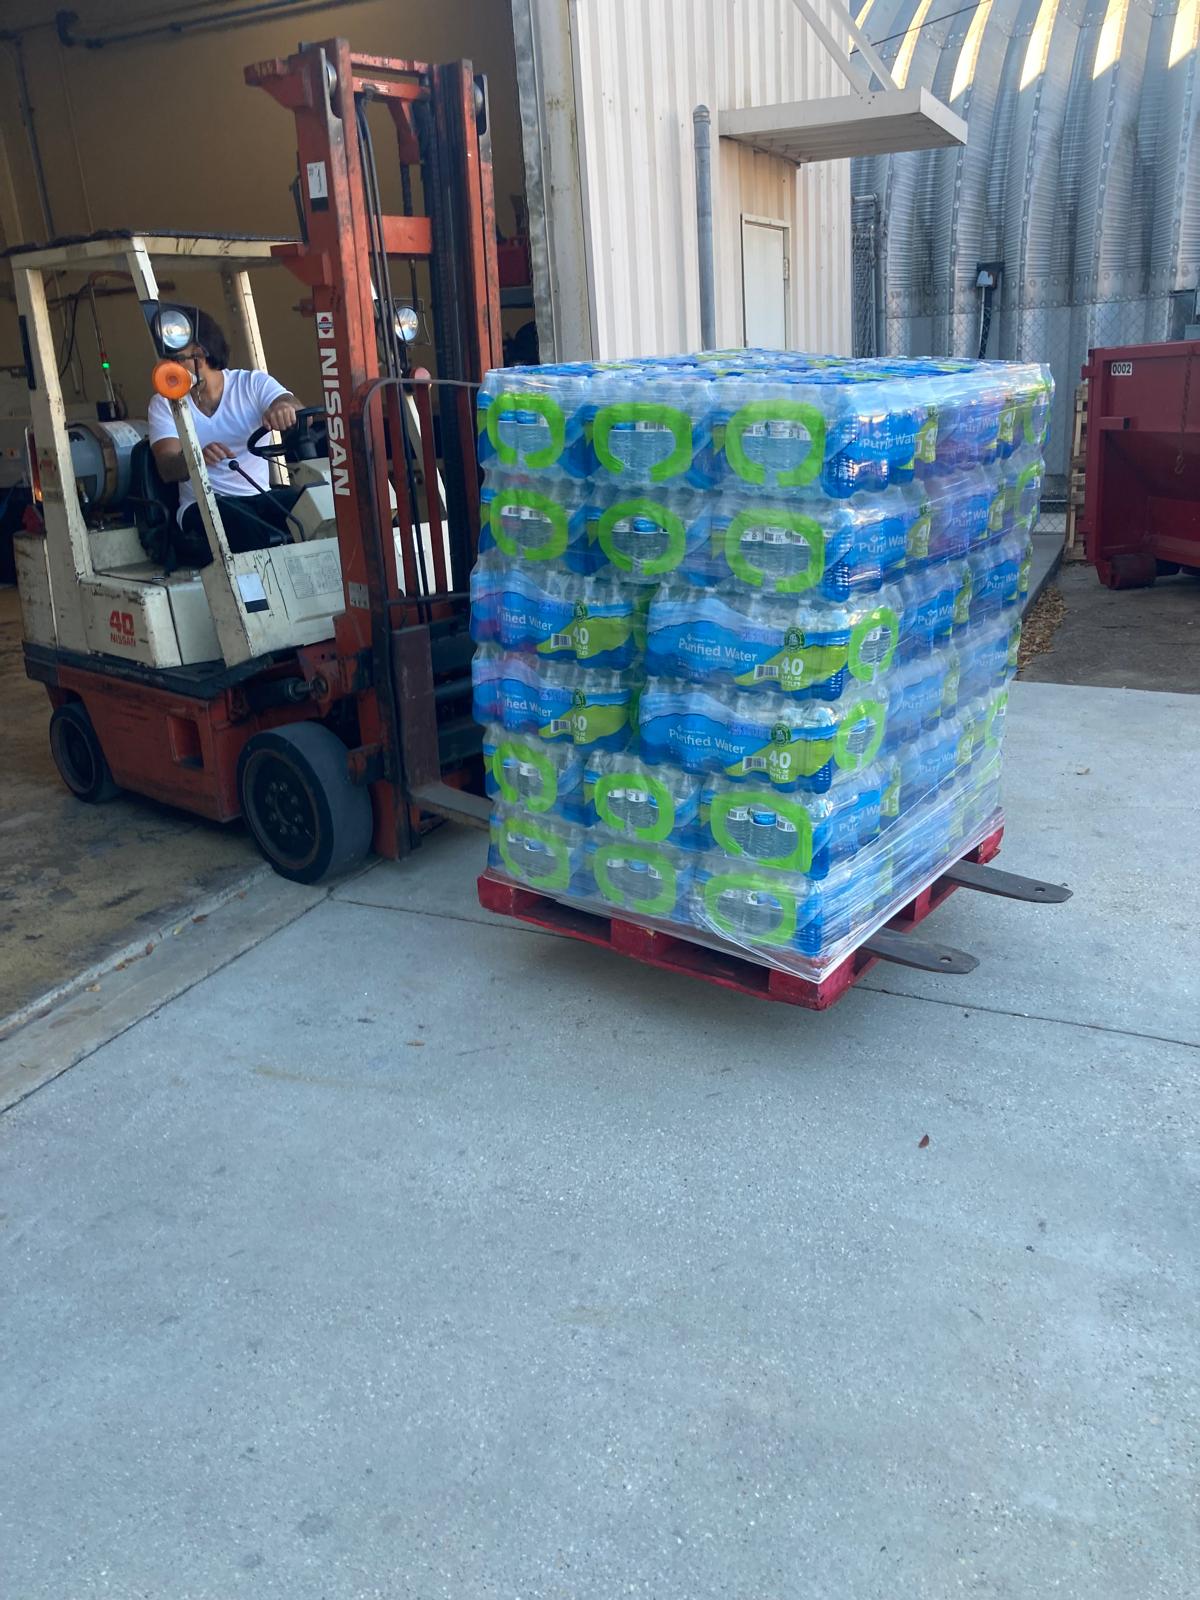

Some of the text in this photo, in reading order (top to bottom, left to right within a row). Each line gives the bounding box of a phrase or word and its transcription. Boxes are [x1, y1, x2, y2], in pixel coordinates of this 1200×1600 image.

[1112, 363, 1131, 374] 0002
[320, 348, 350, 496] NISSAN
[110, 611, 135, 636] 40
[678, 637, 721, 657] Purified
[725, 645, 757, 662] Water
[781, 657, 803, 675] 40
[669, 728, 711, 746] Purified
[715, 737, 745, 754] Water
[769, 750, 792, 769] 40
